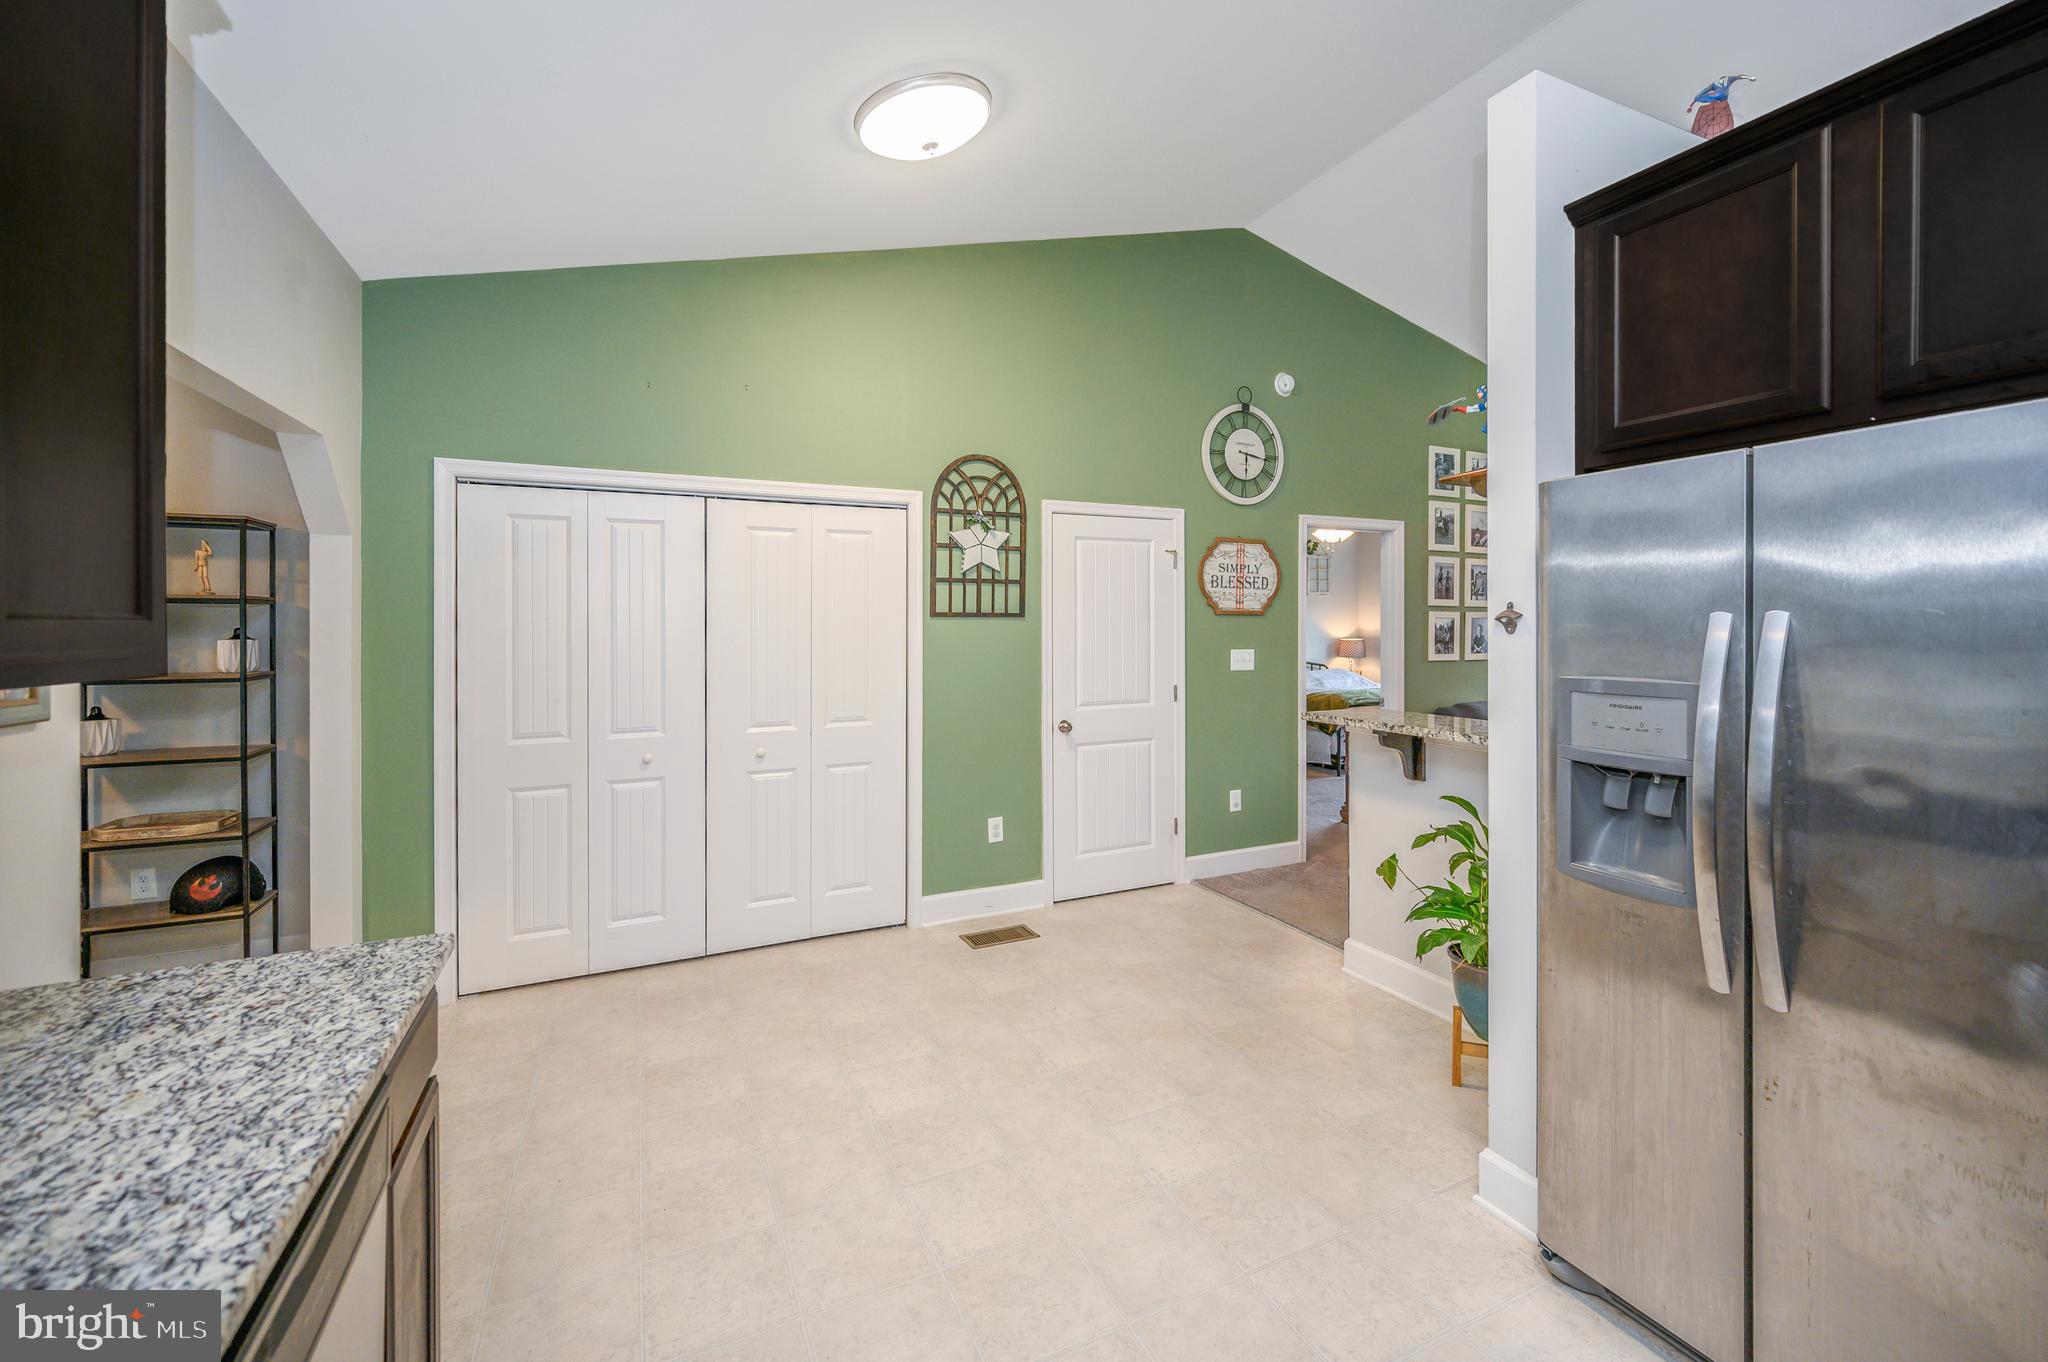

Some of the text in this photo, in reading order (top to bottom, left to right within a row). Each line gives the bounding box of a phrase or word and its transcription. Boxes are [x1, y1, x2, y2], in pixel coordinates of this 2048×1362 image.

[1218, 562, 1263, 574] SIMPLY
[1210, 574, 1269, 590] BLESSED
[1609, 703, 1643, 711] FRIGIDAIRE
